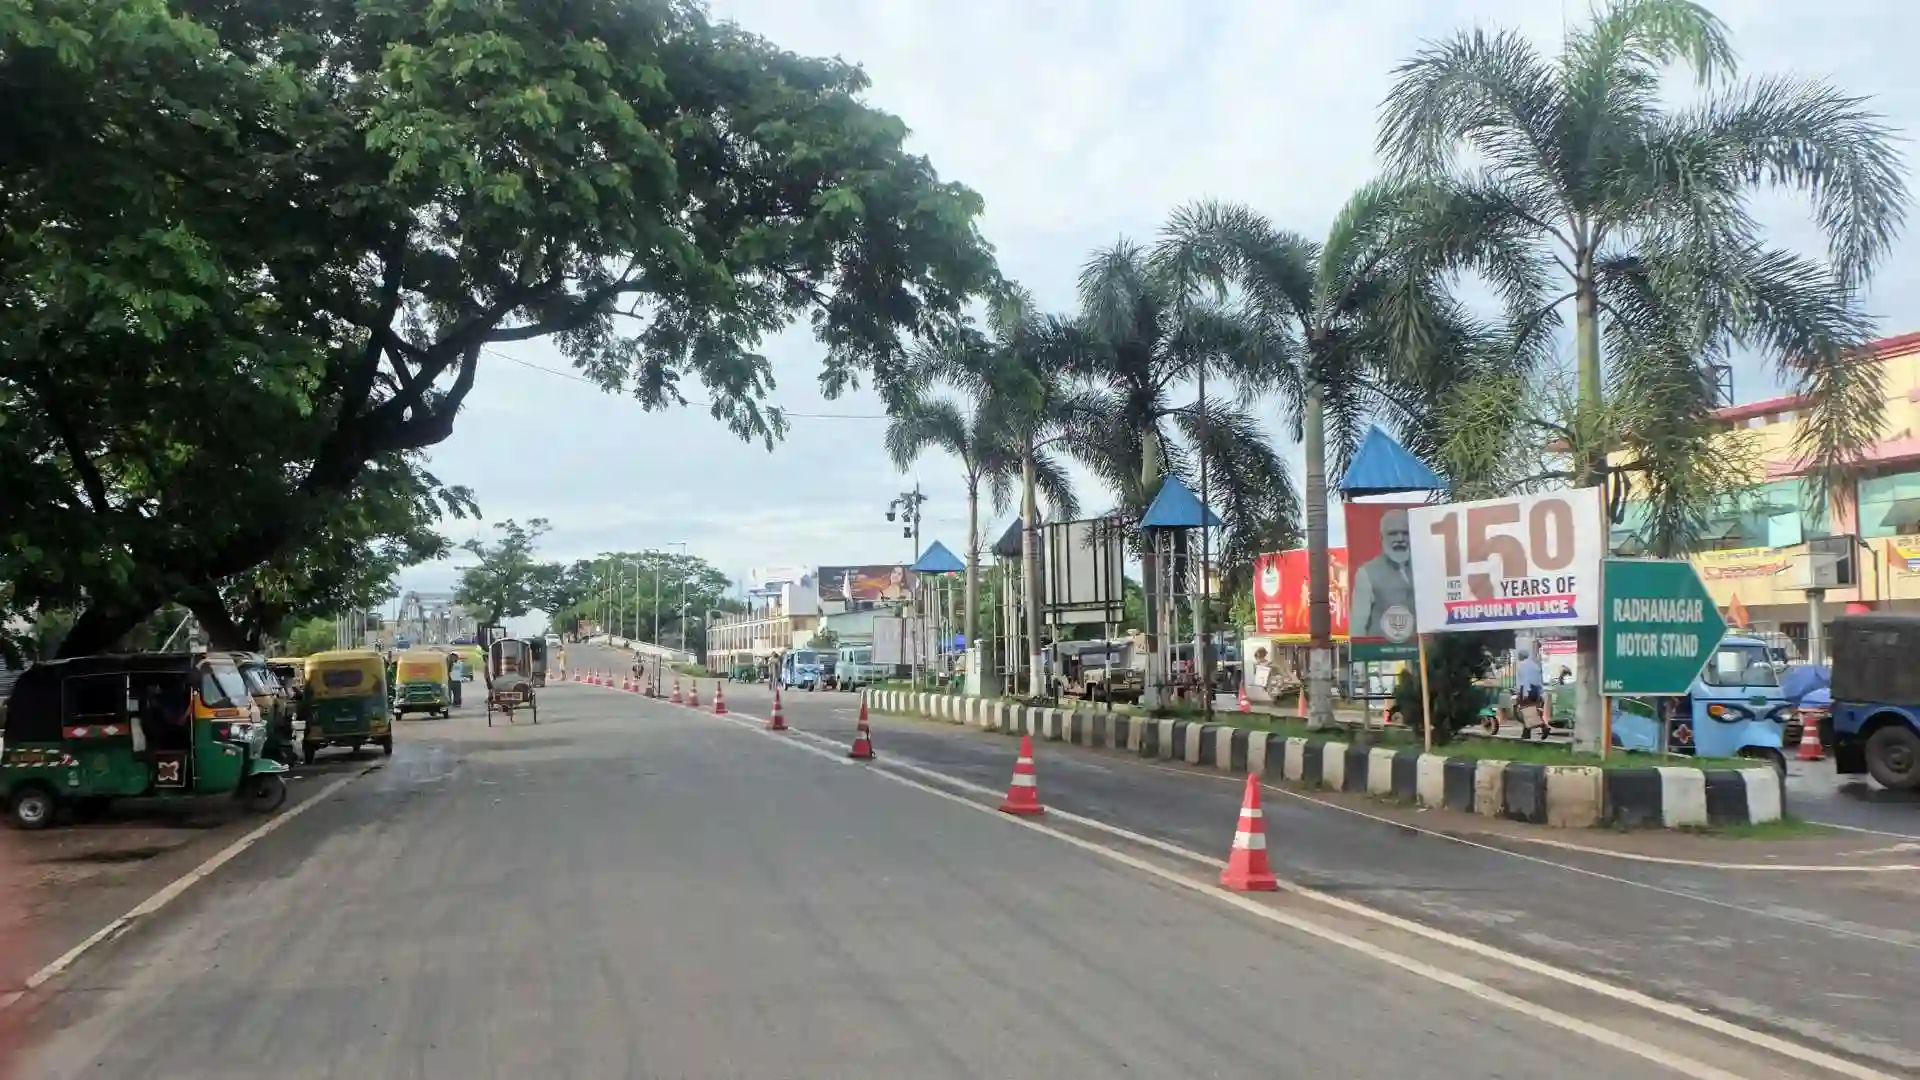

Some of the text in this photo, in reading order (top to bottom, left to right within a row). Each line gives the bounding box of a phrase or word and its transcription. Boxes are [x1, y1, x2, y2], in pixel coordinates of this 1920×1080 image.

[1430, 499, 1575, 600] 150
[1500, 575, 1576, 597] YEARS OF
[1452, 600, 1569, 620] TRIPURA POLICE
[1613, 598, 1703, 622] RADHANAGAR
[1616, 633, 1699, 657] MOTOR STAND
[1604, 680, 1623, 689] AMC
